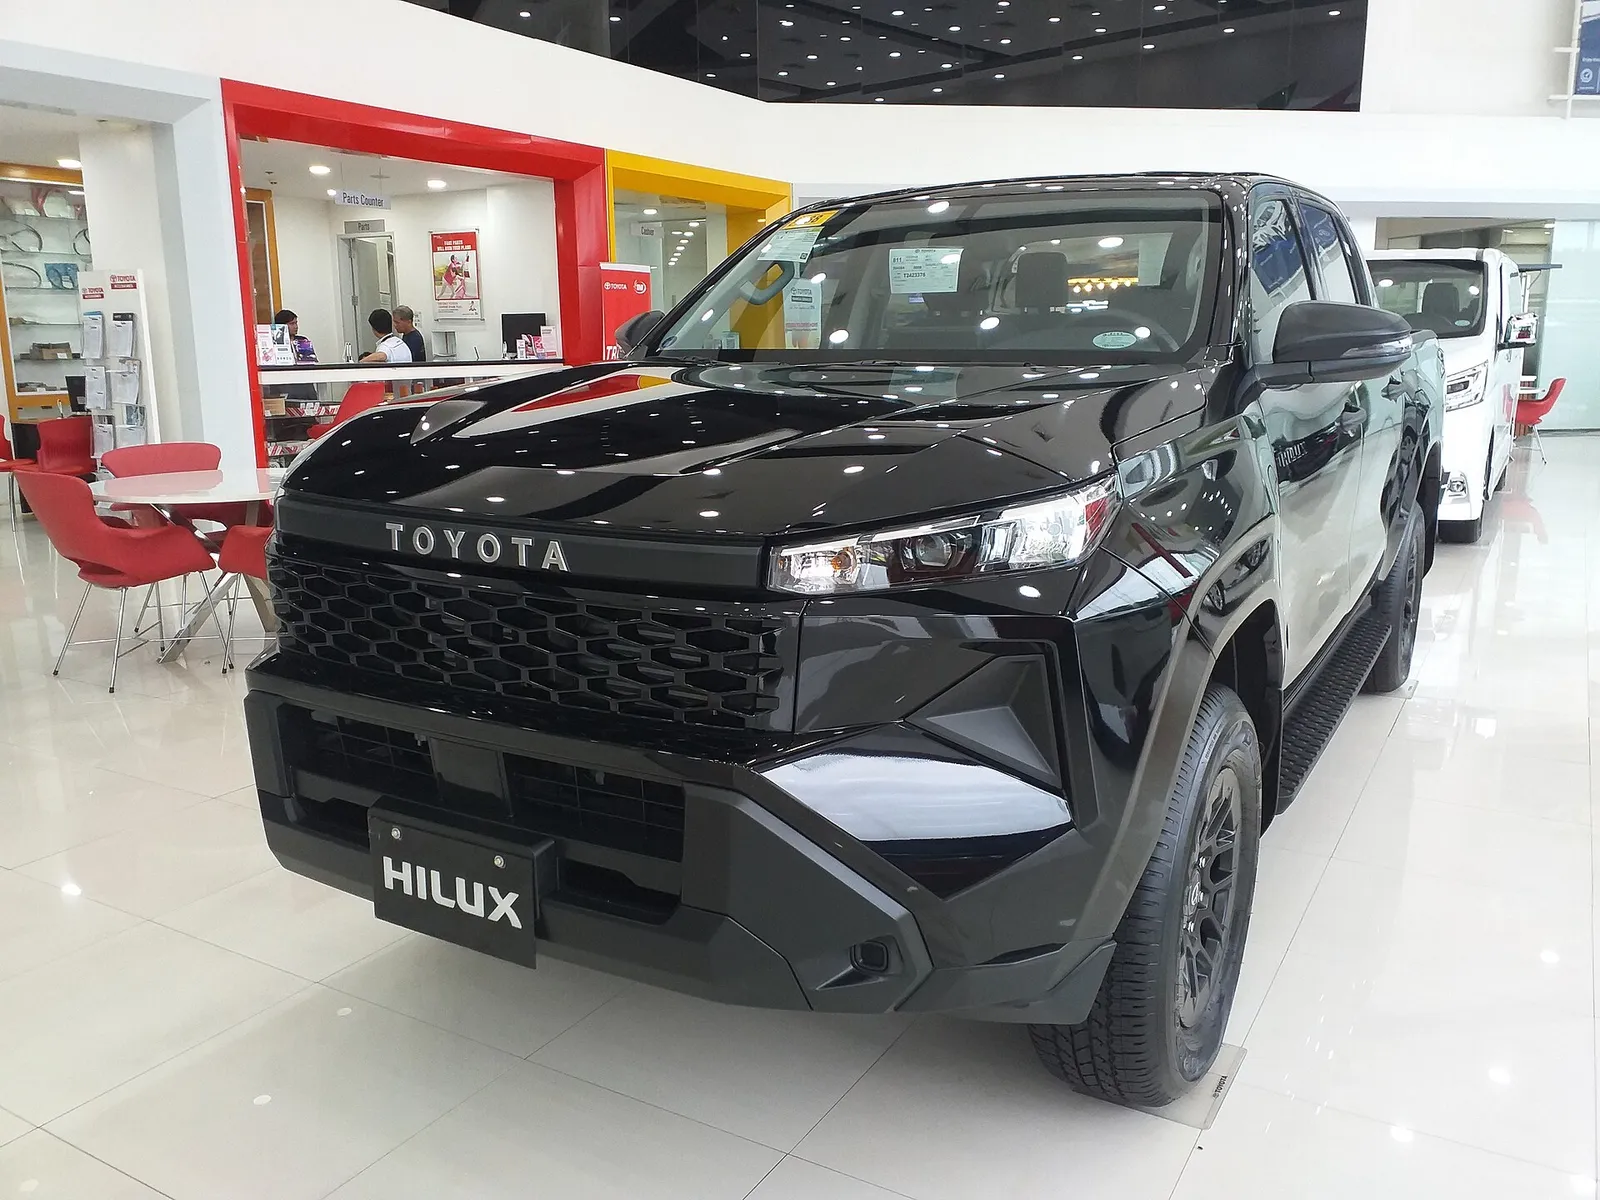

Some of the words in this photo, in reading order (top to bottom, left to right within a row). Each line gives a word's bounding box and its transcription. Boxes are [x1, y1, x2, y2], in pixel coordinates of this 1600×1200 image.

[342, 192, 360, 205] Parts
[360, 194, 384, 207] Counter
[357, 222, 370, 231] Parts
[385, 522, 571, 572] TOYOTA
[383, 856, 523, 929] HILUX
[1214, 1075, 1228, 1094] TOYOTA
